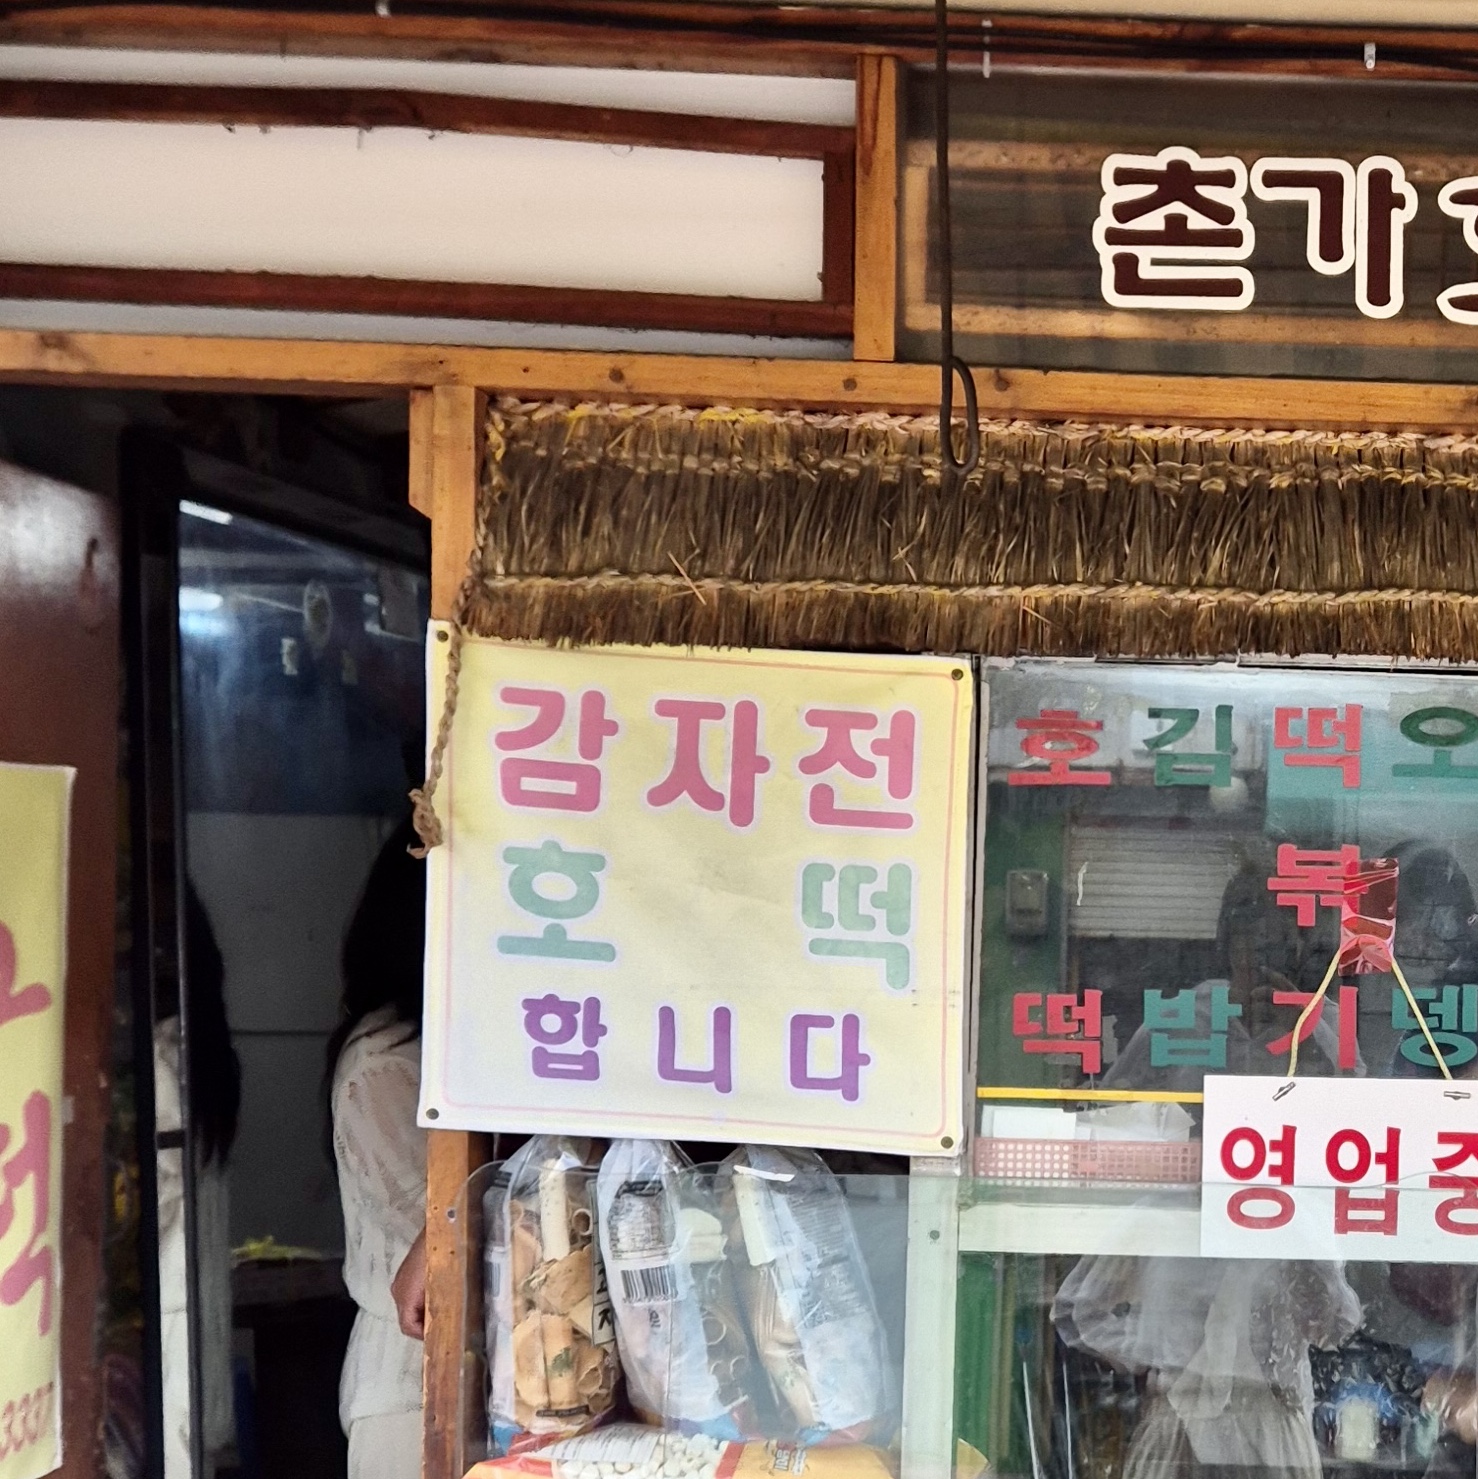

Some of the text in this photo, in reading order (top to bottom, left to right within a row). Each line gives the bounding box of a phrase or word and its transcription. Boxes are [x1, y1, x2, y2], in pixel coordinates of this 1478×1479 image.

[494, 686, 916, 830] 감자전
[496, 839, 913, 991] 호떡
[521, 993, 871, 1103] 합니다
